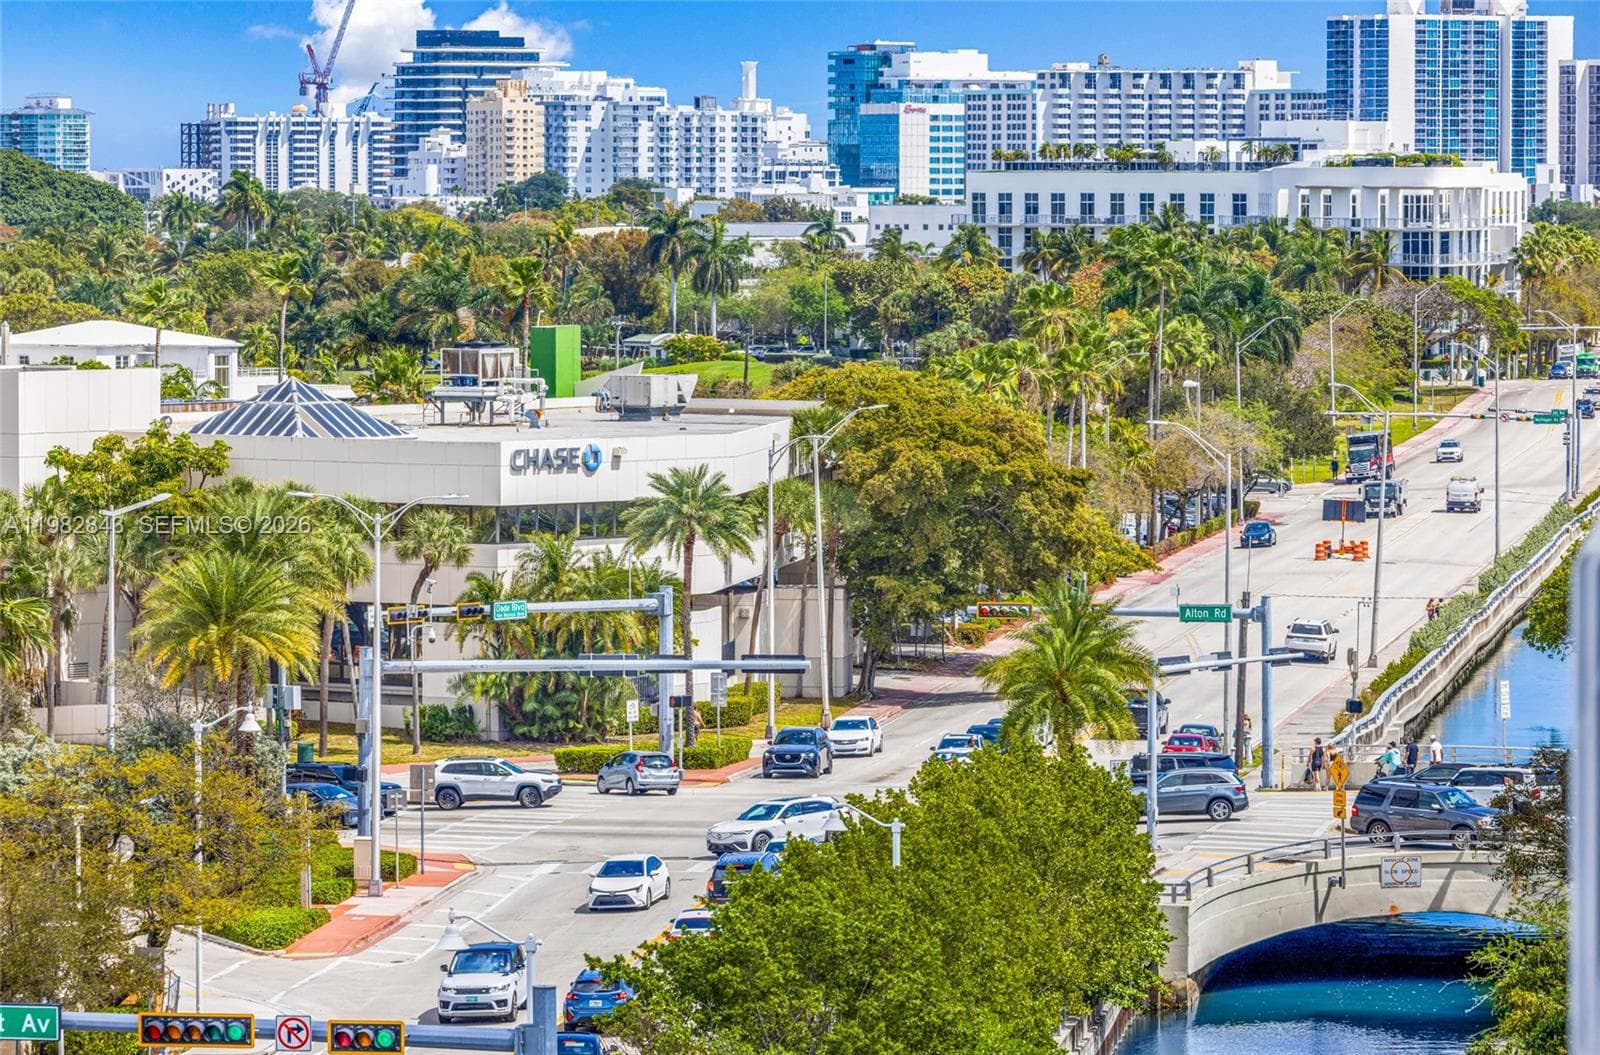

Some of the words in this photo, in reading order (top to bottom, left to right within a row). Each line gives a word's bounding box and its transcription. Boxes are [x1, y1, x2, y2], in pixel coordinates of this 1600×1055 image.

[510, 447, 580, 472] CHASE
[511, 603, 525, 612] Blvd
[1185, 608, 1209, 618] Alton
[1214, 608, 1227, 618] Rd
[21, 1013, 50, 1033] Av
